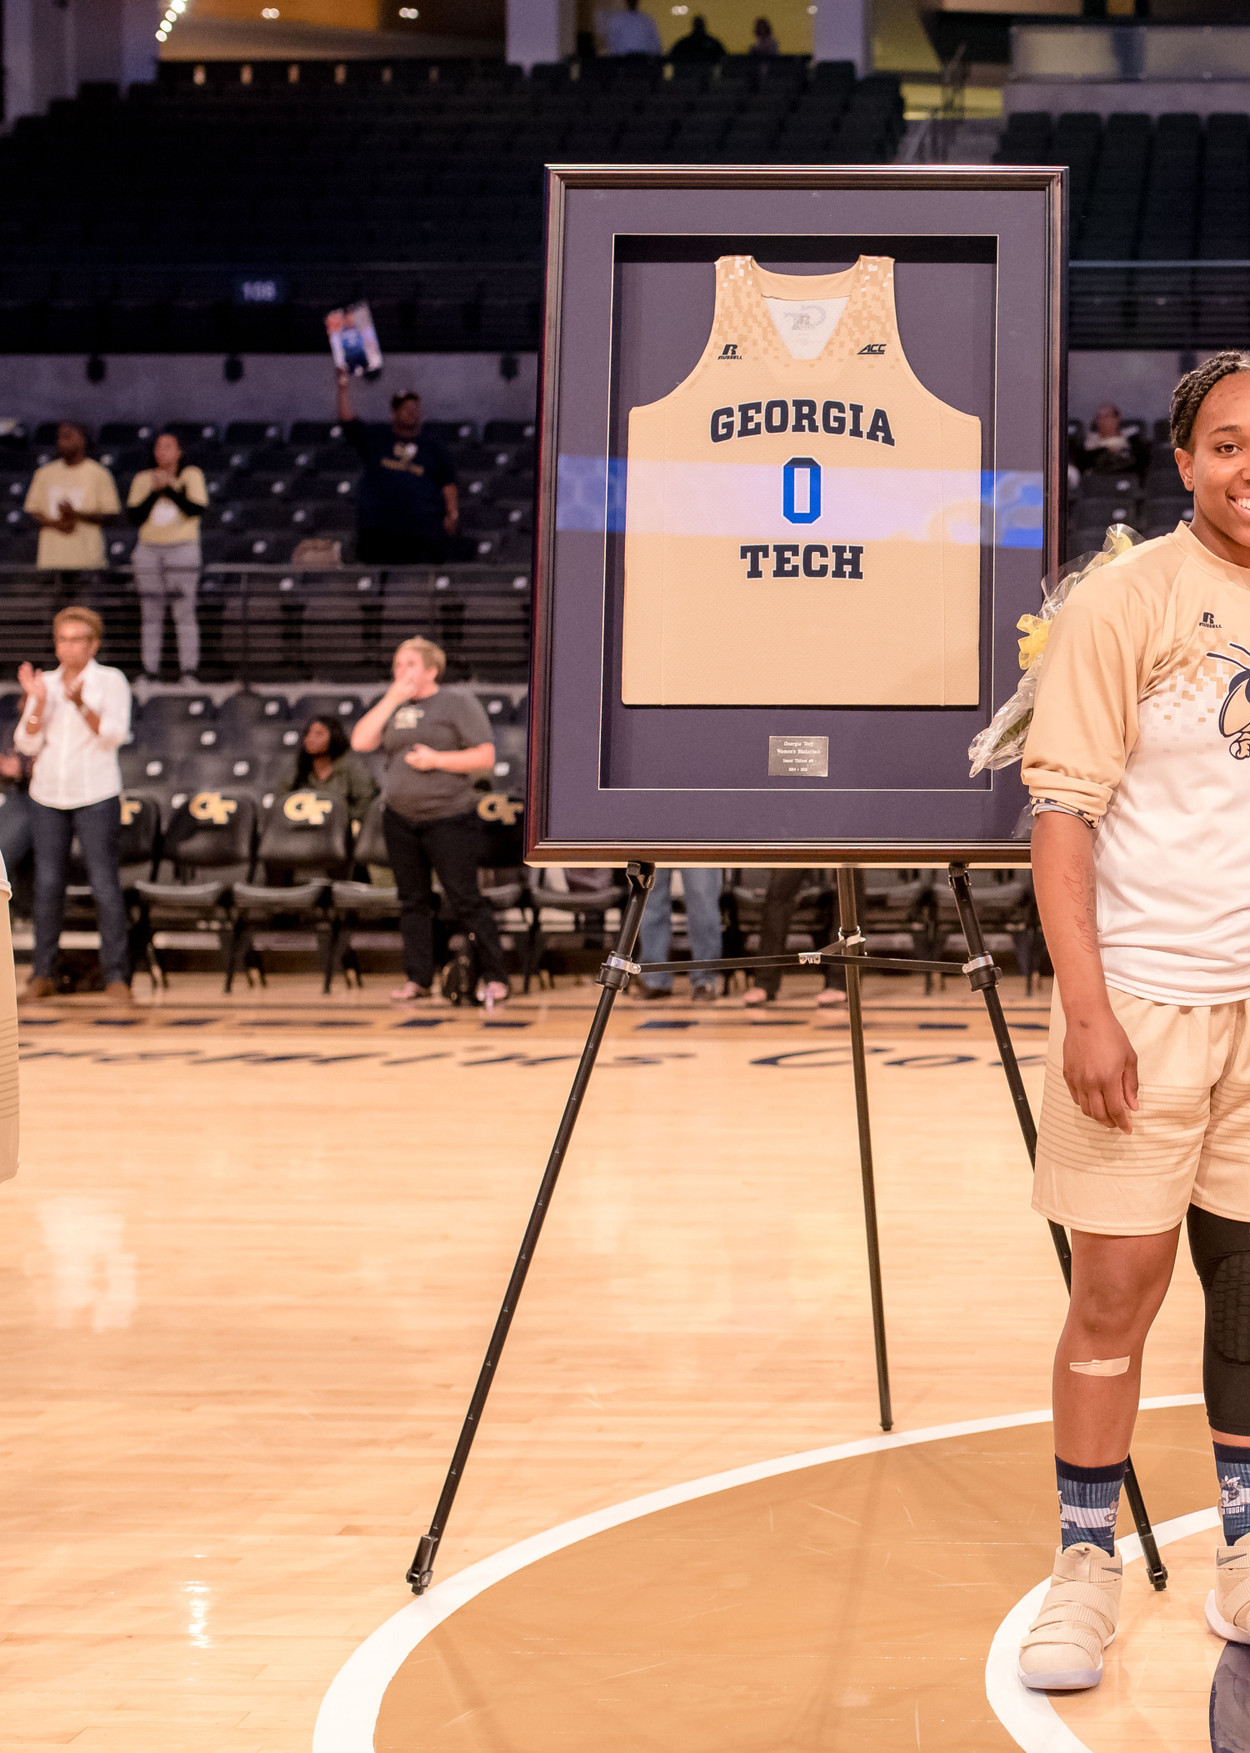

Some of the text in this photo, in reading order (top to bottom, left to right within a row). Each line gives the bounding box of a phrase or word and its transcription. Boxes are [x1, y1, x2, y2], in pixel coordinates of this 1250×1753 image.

[857, 344, 887, 355] ACC
[710, 399, 896, 447] GEORGIA
[782, 456, 822, 525] 0
[739, 543, 864, 581] TECH
[18, 1043, 695, 1068] remins
